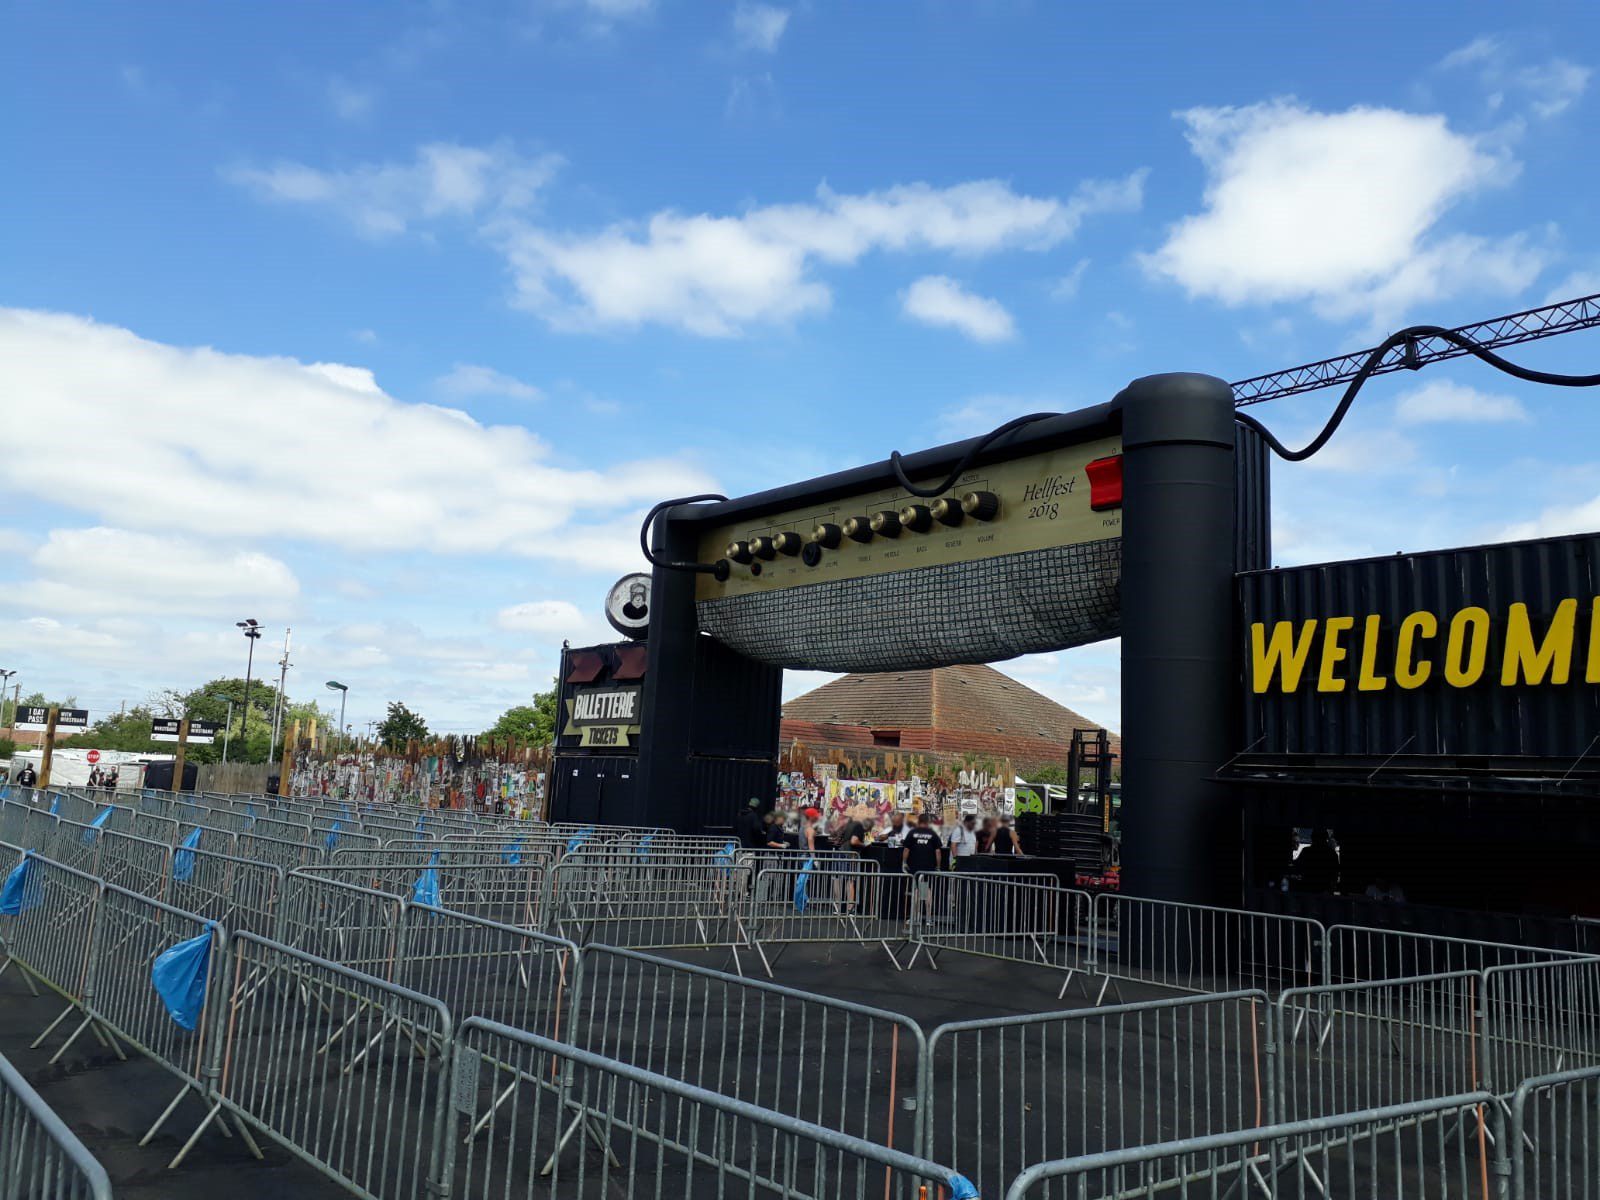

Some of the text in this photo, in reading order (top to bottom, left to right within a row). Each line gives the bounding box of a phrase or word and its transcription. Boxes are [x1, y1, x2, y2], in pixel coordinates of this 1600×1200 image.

[1023, 475, 1076, 503] Hellfest
[1028, 502, 1059, 521] 2018
[32, 708, 45, 716] DAY
[574, 691, 637, 720] BILLETTERIE
[27, 715, 44, 723] PASS
[588, 727, 619, 745] TICKETS
